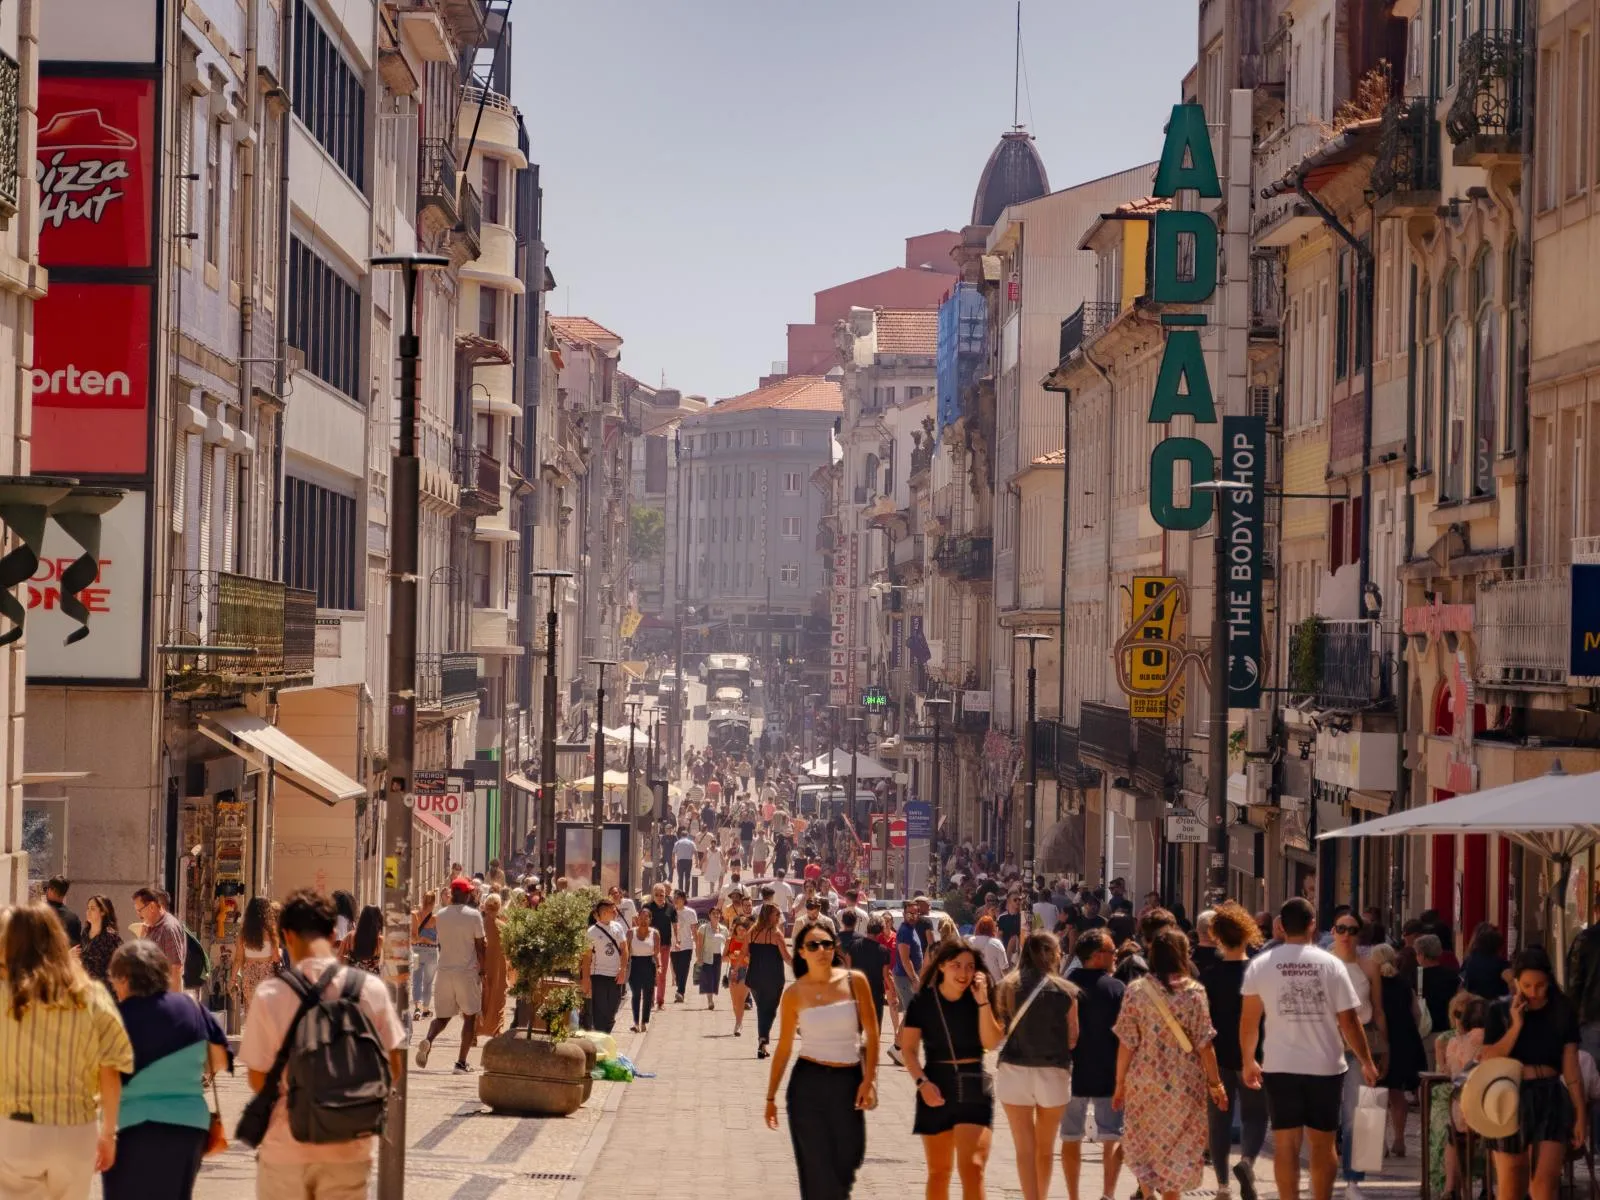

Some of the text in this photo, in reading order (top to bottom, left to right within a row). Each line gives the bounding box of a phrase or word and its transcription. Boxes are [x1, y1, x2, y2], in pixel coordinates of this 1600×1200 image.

[38, 187, 124, 234] Hut
[1230, 433, 1254, 640] THE BODY SHOP
[833, 535, 846, 684] PERFECTA
[1143, 581, 1165, 667] OURO
